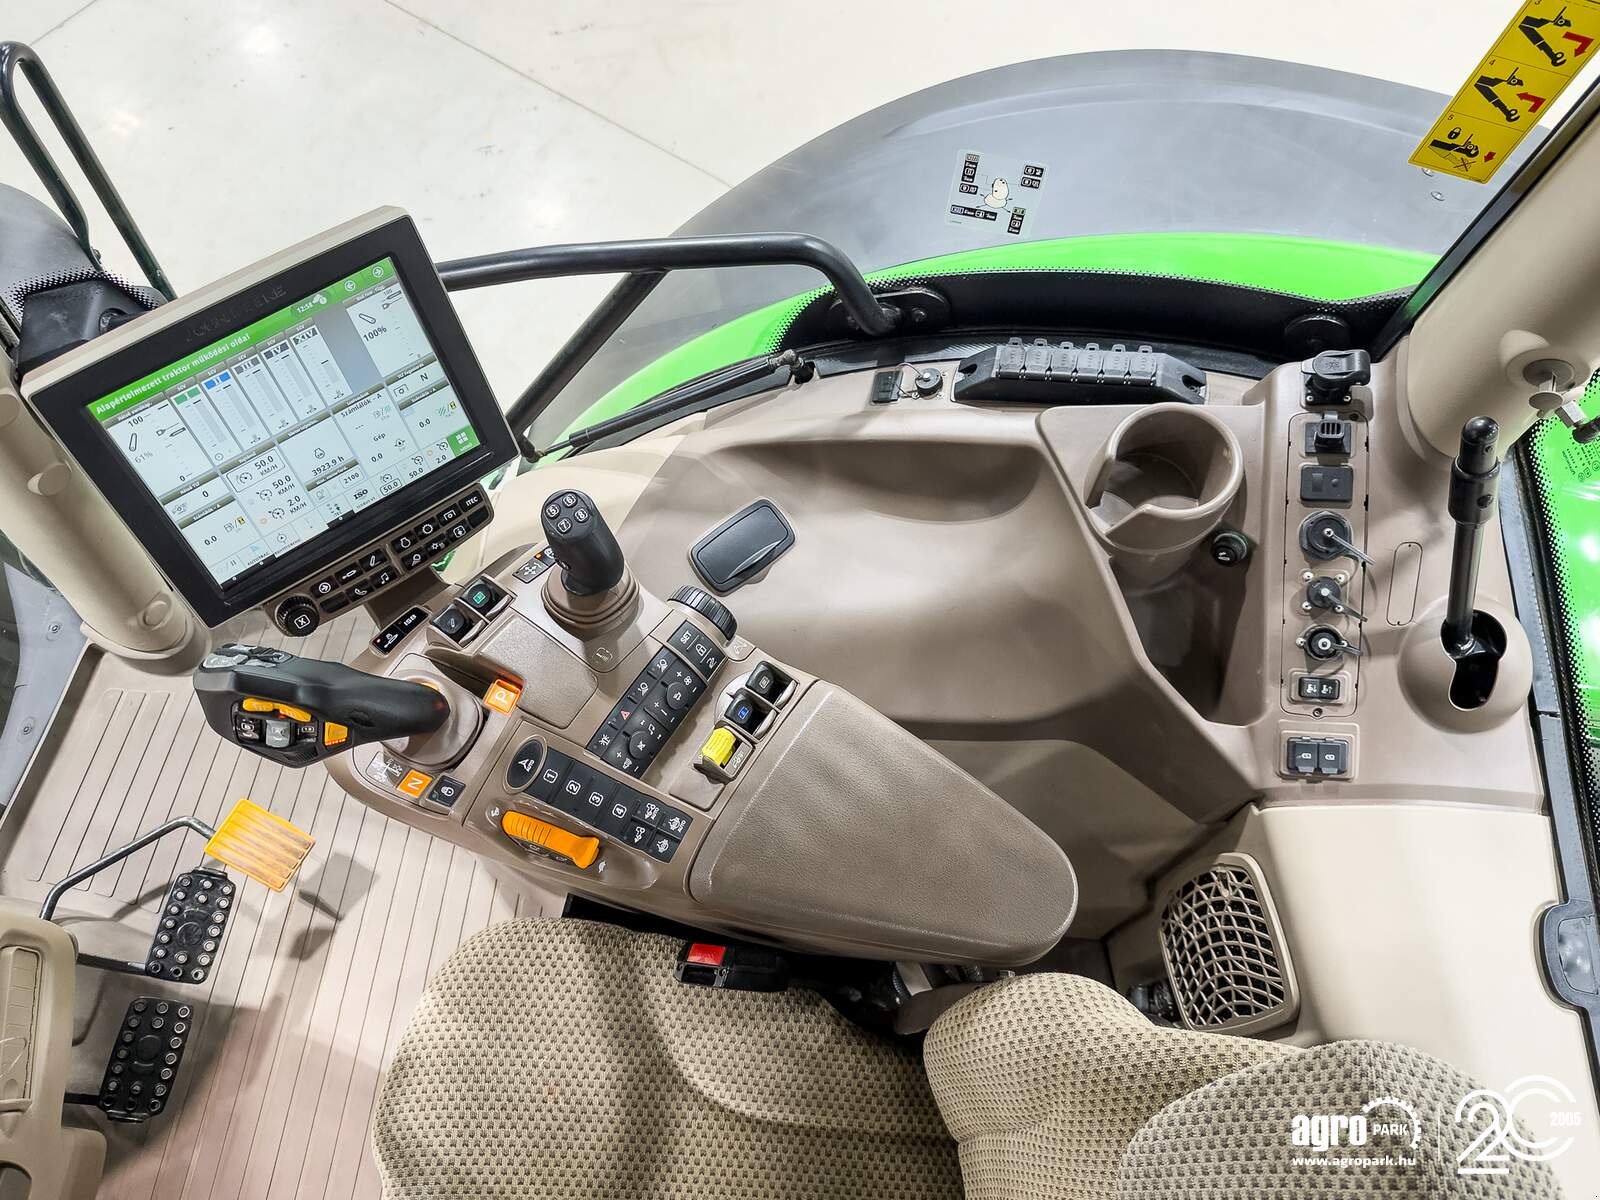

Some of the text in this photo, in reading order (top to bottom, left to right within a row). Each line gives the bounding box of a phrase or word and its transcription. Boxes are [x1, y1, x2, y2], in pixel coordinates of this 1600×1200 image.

[295, 330, 314, 343] XIV
[363, 325, 386, 341] 100%
[161, 363, 190, 380] traktor
[228, 332, 250, 347] oldal
[270, 345, 283, 356] IV
[128, 416, 143, 426] 100
[418, 418, 430, 427] 0.0
[372, 431, 386, 442] Gép
[254, 455, 274, 469] 50.0
[371, 453, 383, 462] 0.0
[436, 454, 446, 463] 2.0
[311, 459, 337, 475] 3923.9
[408, 467, 423, 478] 50.0
[272, 475, 291, 488] 50.0
[343, 472, 359, 483] 2100
[382, 481, 398, 492] 50.0
[353, 488, 368, 499] ISO
[286, 495, 301, 506] 2.0
[466, 496, 478, 506] ITEC
[203, 535, 217, 545] 0.0
[680, 630, 692, 644] SET
[407, 777, 424, 790] N
